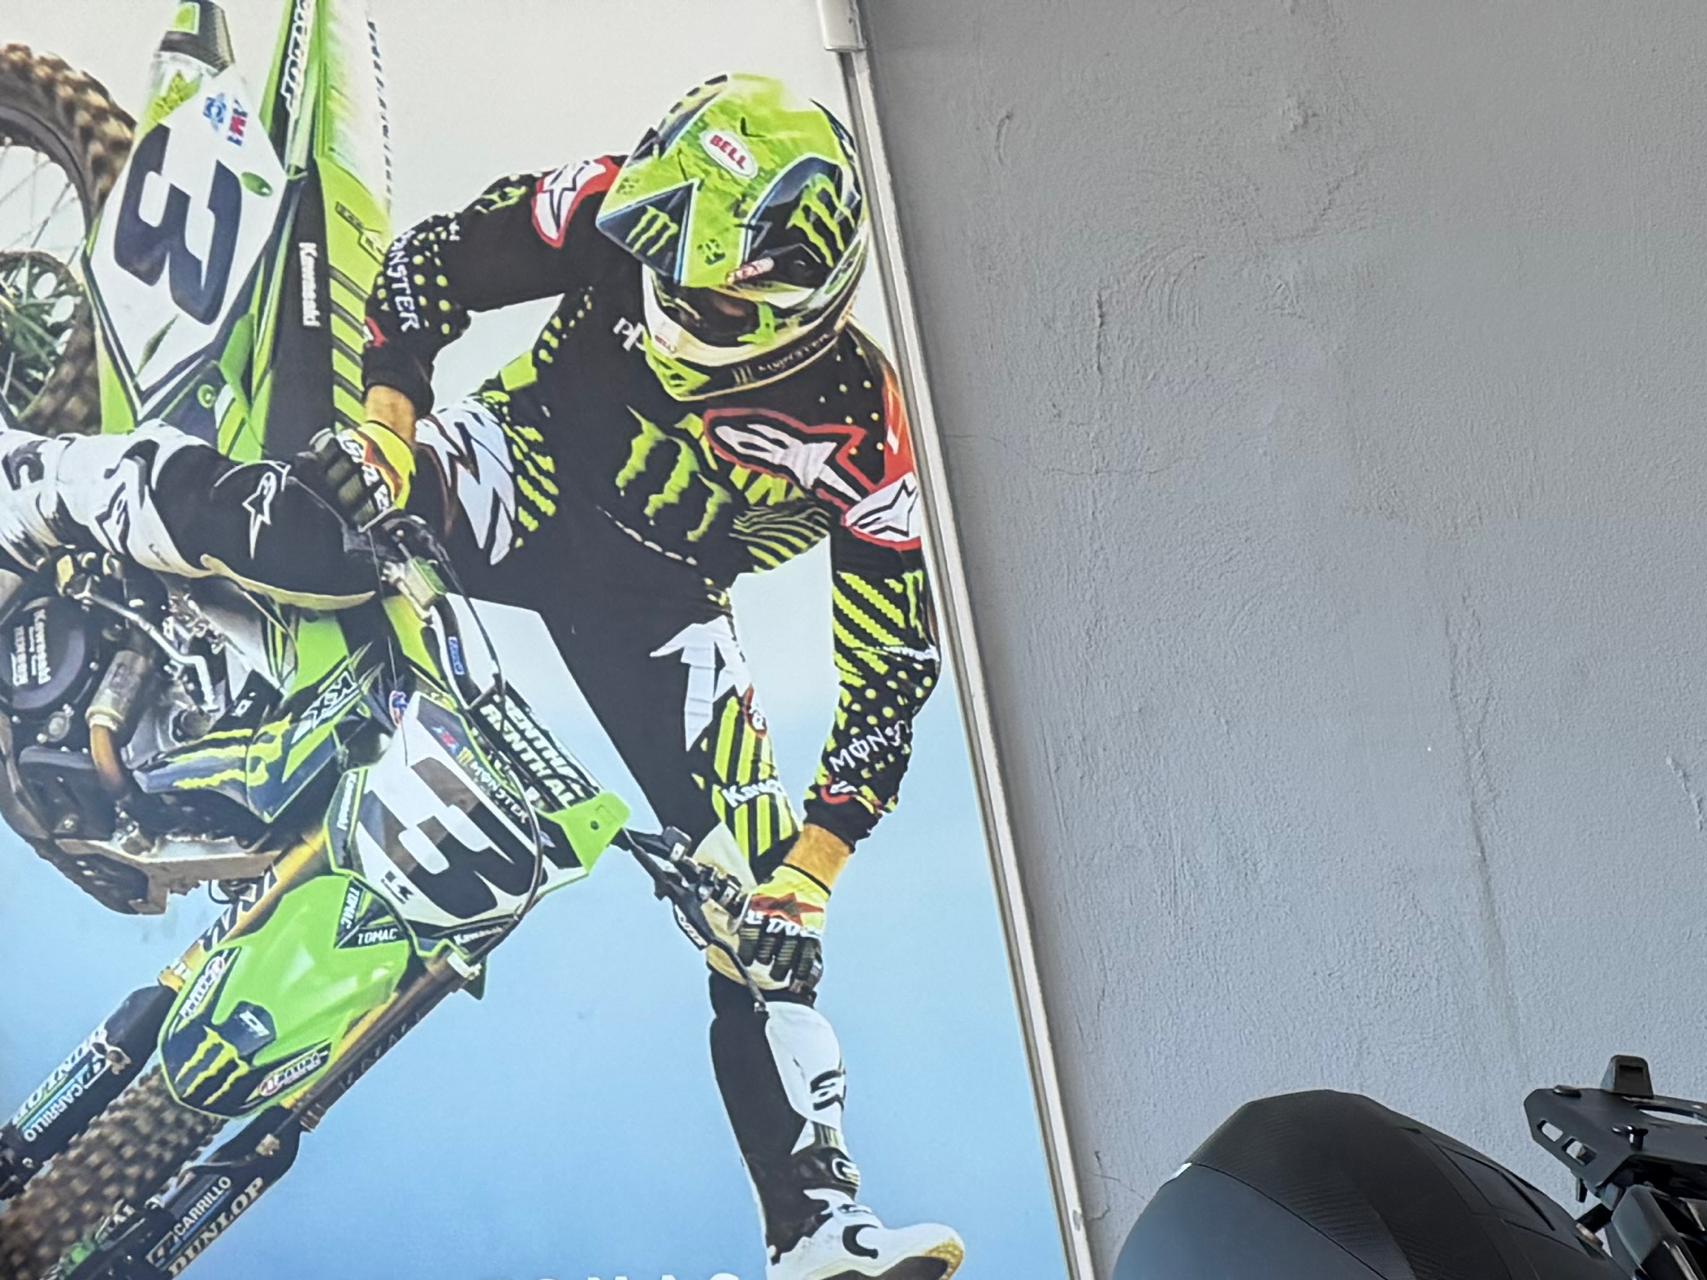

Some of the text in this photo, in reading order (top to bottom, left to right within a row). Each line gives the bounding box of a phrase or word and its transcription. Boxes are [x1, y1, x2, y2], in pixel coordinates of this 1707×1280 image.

[709, 133, 748, 169] BELL
[114, 123, 244, 326] 3
[358, 756, 550, 920] 3
[356, 927, 399, 946] TOMAC
[23, 1081, 84, 1143] CARRILLO
[167, 1176, 264, 1277] DUNLOP
[174, 1176, 232, 1241] CARRILLO
